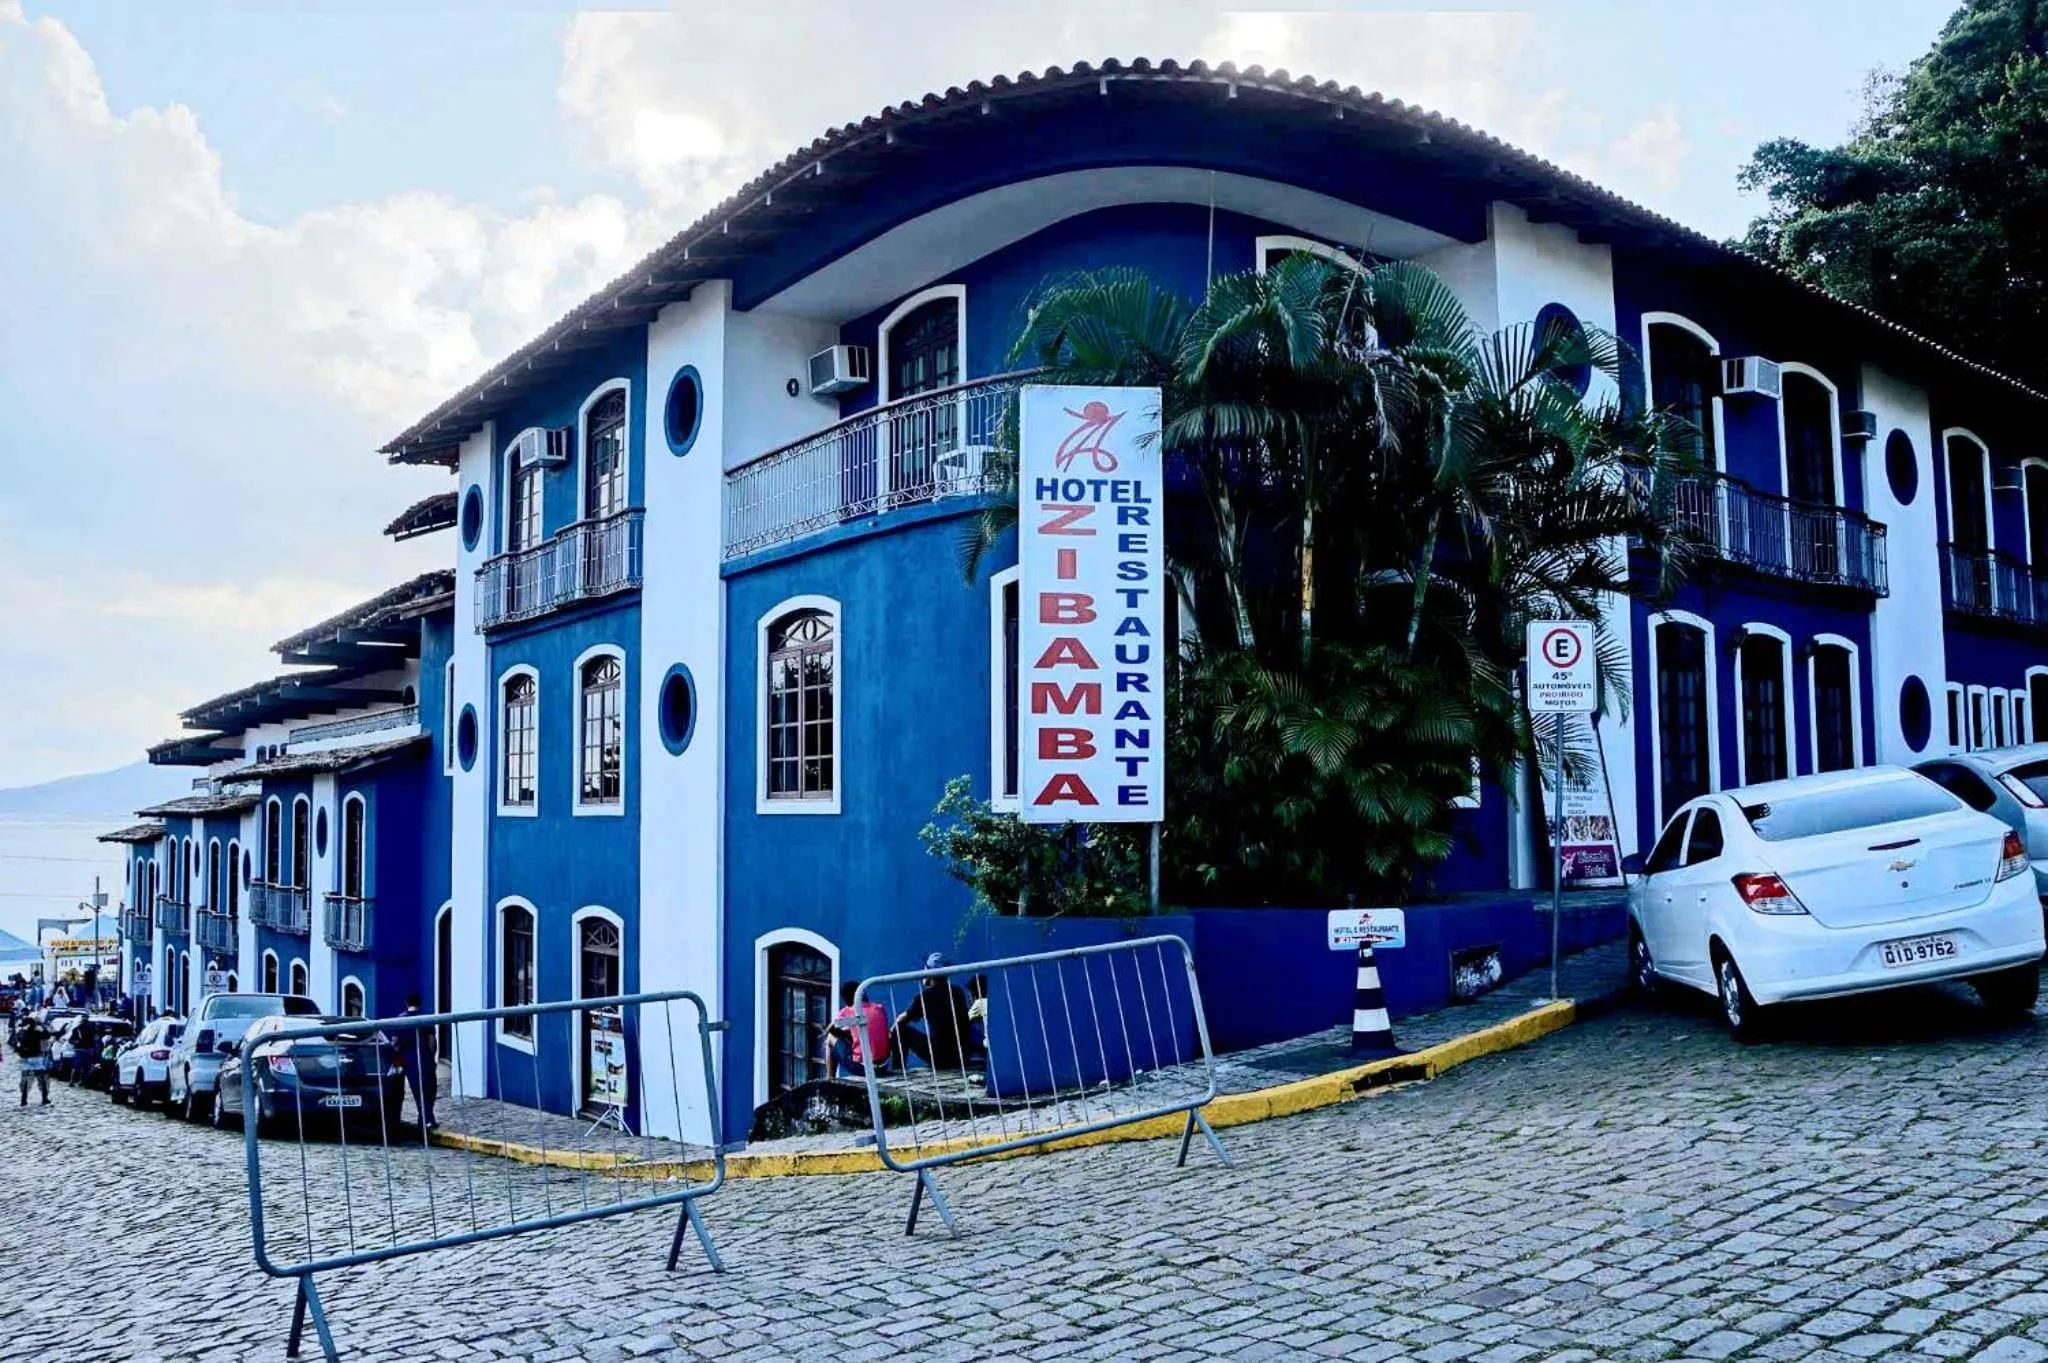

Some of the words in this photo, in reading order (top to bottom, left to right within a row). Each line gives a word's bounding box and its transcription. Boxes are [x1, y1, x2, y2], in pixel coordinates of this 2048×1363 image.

[1036, 478, 1152, 503] HOTEL
[1031, 503, 1102, 806] ZIBAMBA
[1114, 506, 1151, 806] RESTAURANTE
[1555, 639, 1569, 658] E
